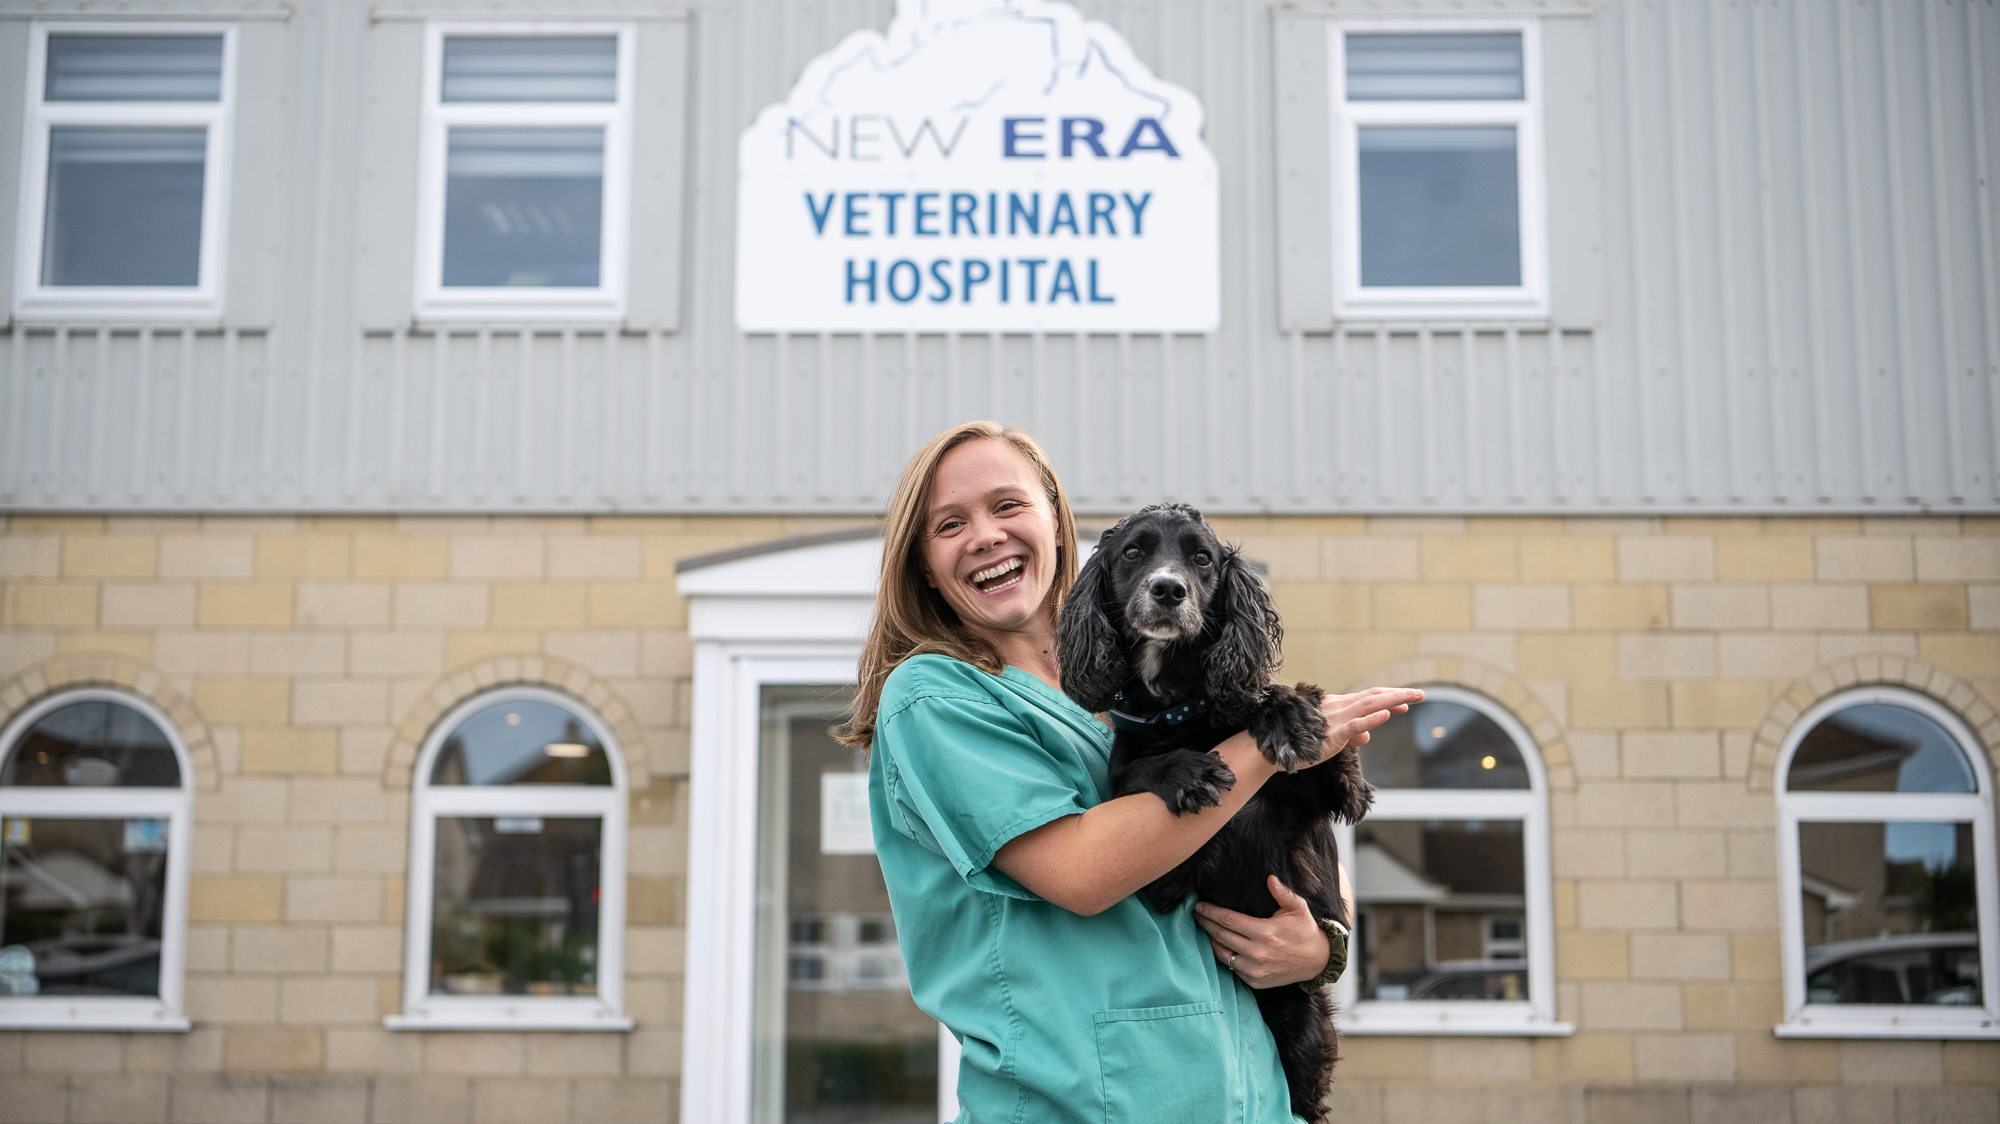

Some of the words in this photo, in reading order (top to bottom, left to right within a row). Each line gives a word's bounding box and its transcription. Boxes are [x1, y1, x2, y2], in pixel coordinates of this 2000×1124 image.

[787, 115, 969, 161] NEW
[1002, 116, 1182, 160] ERA
[804, 191, 1154, 237] VETERINARY
[844, 258, 1116, 305] HOSPITAL
